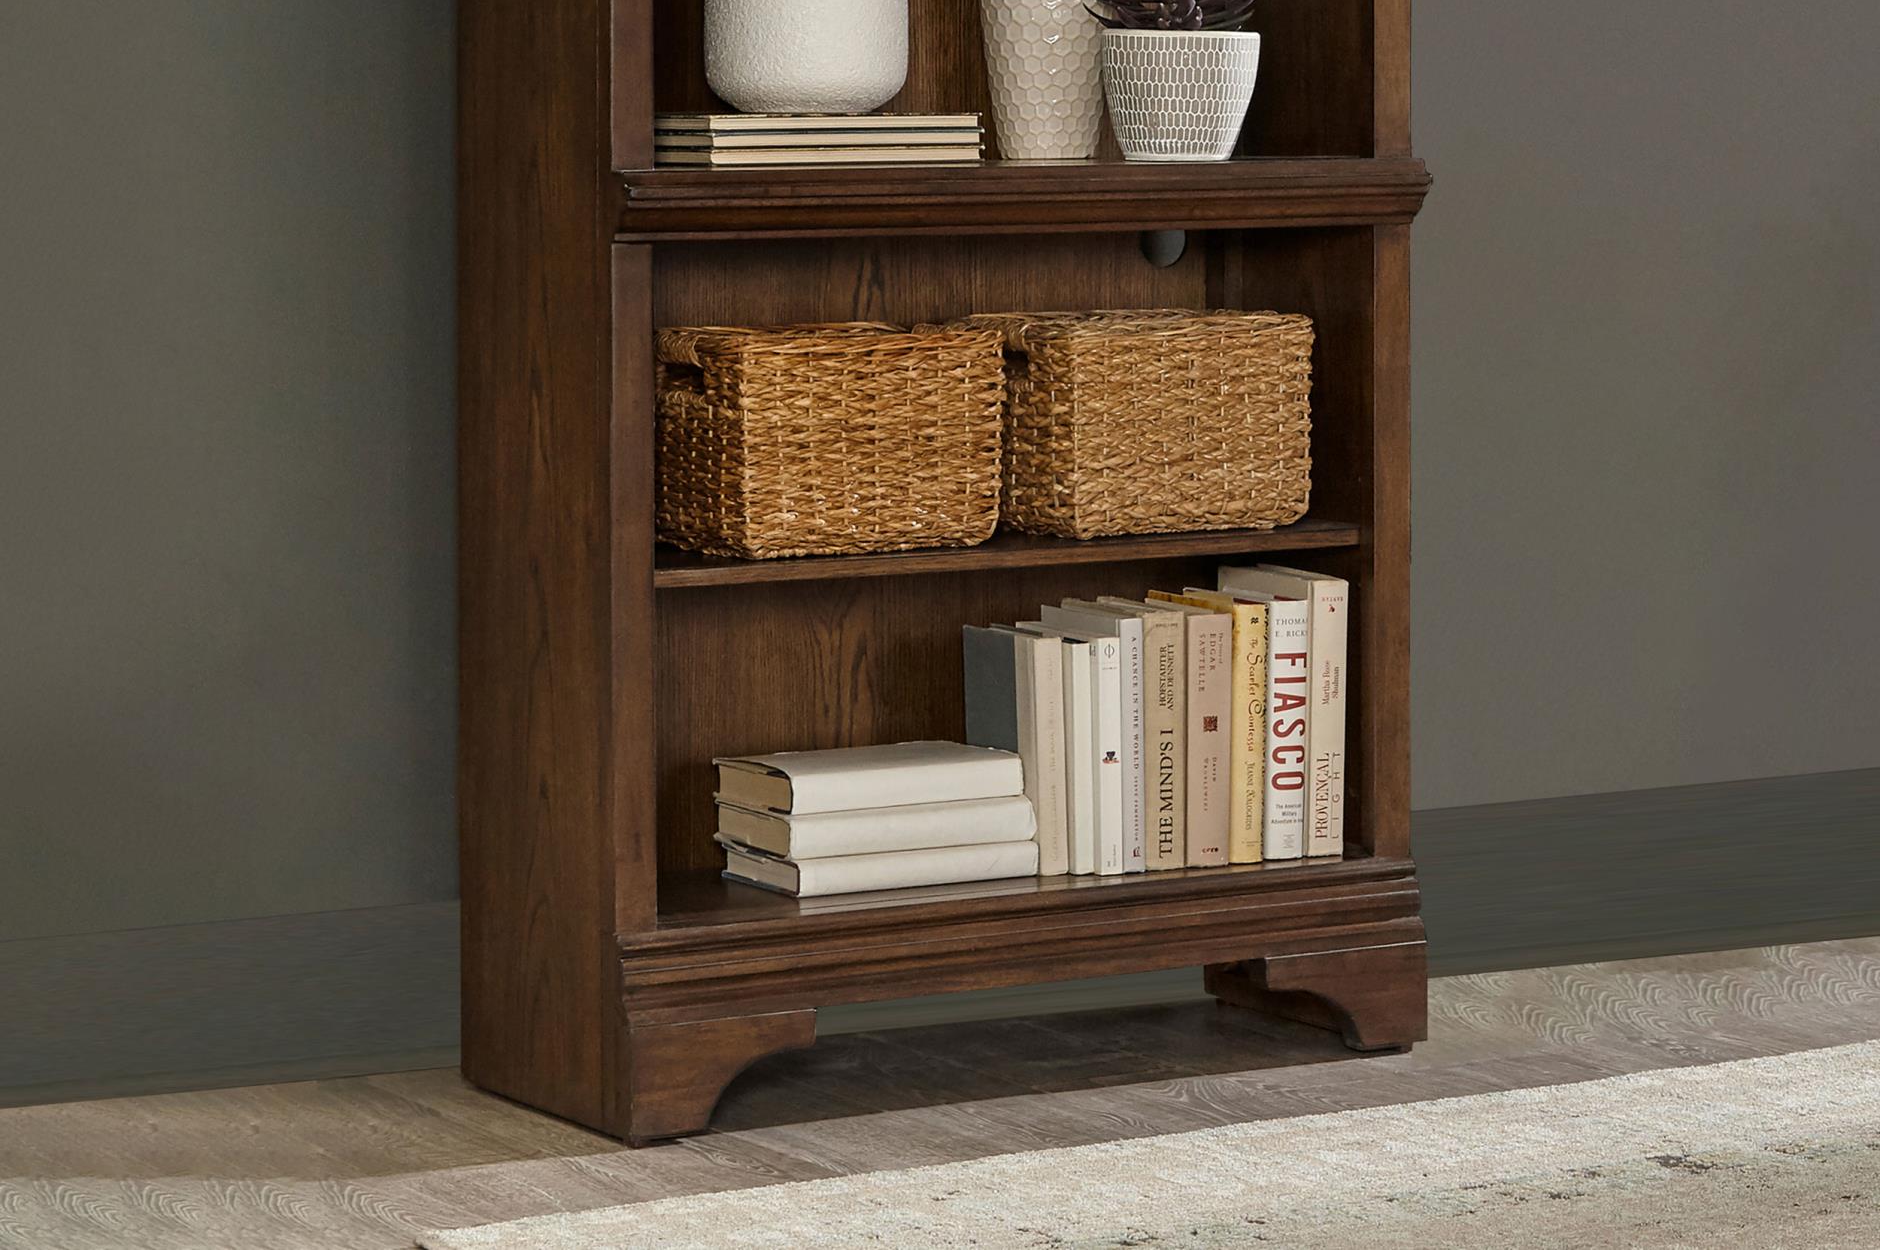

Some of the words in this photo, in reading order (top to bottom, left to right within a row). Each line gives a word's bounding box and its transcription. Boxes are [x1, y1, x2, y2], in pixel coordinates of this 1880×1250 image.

[1275, 617, 1308, 626] THOMA
[1166, 643, 1175, 688] DENNETT
[1198, 633, 1206, 692] SAWTELLE
[1209, 633, 1217, 671] EDGAR
[1247, 652, 1263, 697] Scarlet
[1132, 693, 1139, 704] IN
[1158, 645, 1167, 708] HOFSTADTER
[1321, 680, 1331, 705] Martha
[1331, 666, 1340, 699] Shulman
[1166, 689, 1175, 711] AND
[1271, 652, 1308, 791] FIASCO
[1159, 728, 1174, 737] I
[1246, 699, 1265, 752] Contessa
[1159, 741, 1174, 813] MIND'S
[1314, 752, 1332, 839] PROVENÇAL
[1331, 751, 1341, 839] LIGHT
[1159, 816, 1174, 859] THE
